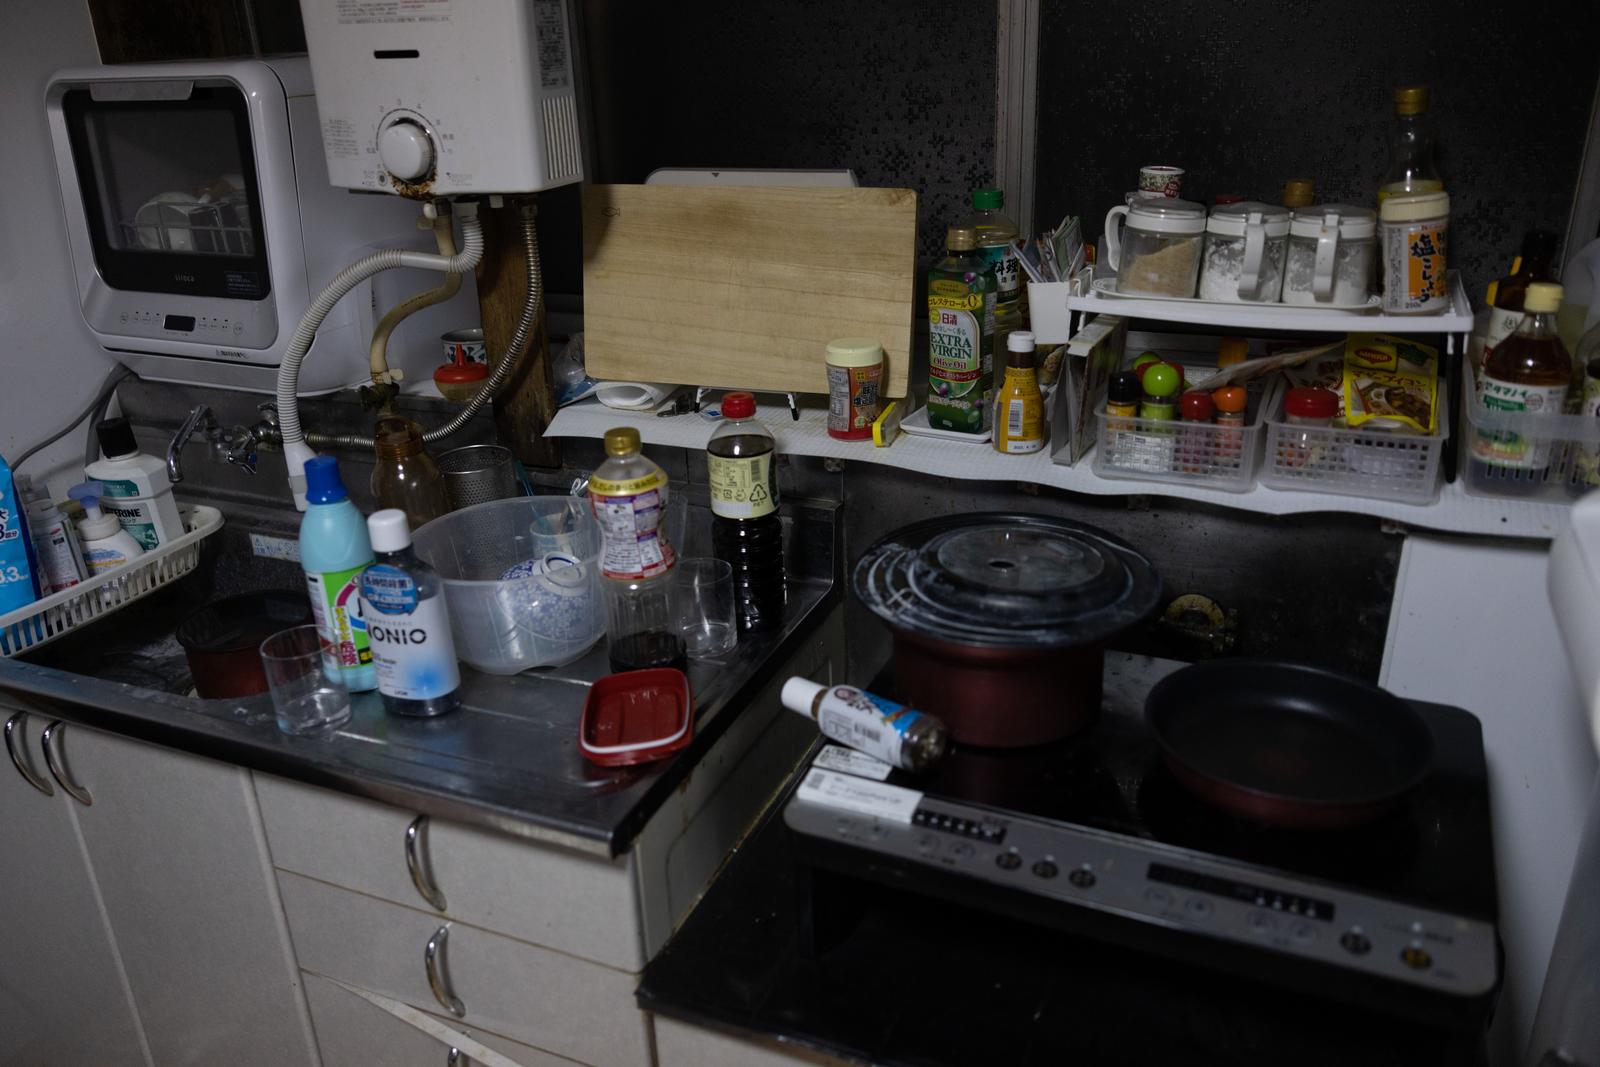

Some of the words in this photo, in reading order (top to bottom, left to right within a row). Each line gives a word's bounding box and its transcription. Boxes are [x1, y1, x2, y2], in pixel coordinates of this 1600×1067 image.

[930, 332, 972, 348] EXTRA
[931, 343, 973, 359] VIRGIN
[933, 356, 953, 367] Olive
[953, 360, 967, 369] Oil
